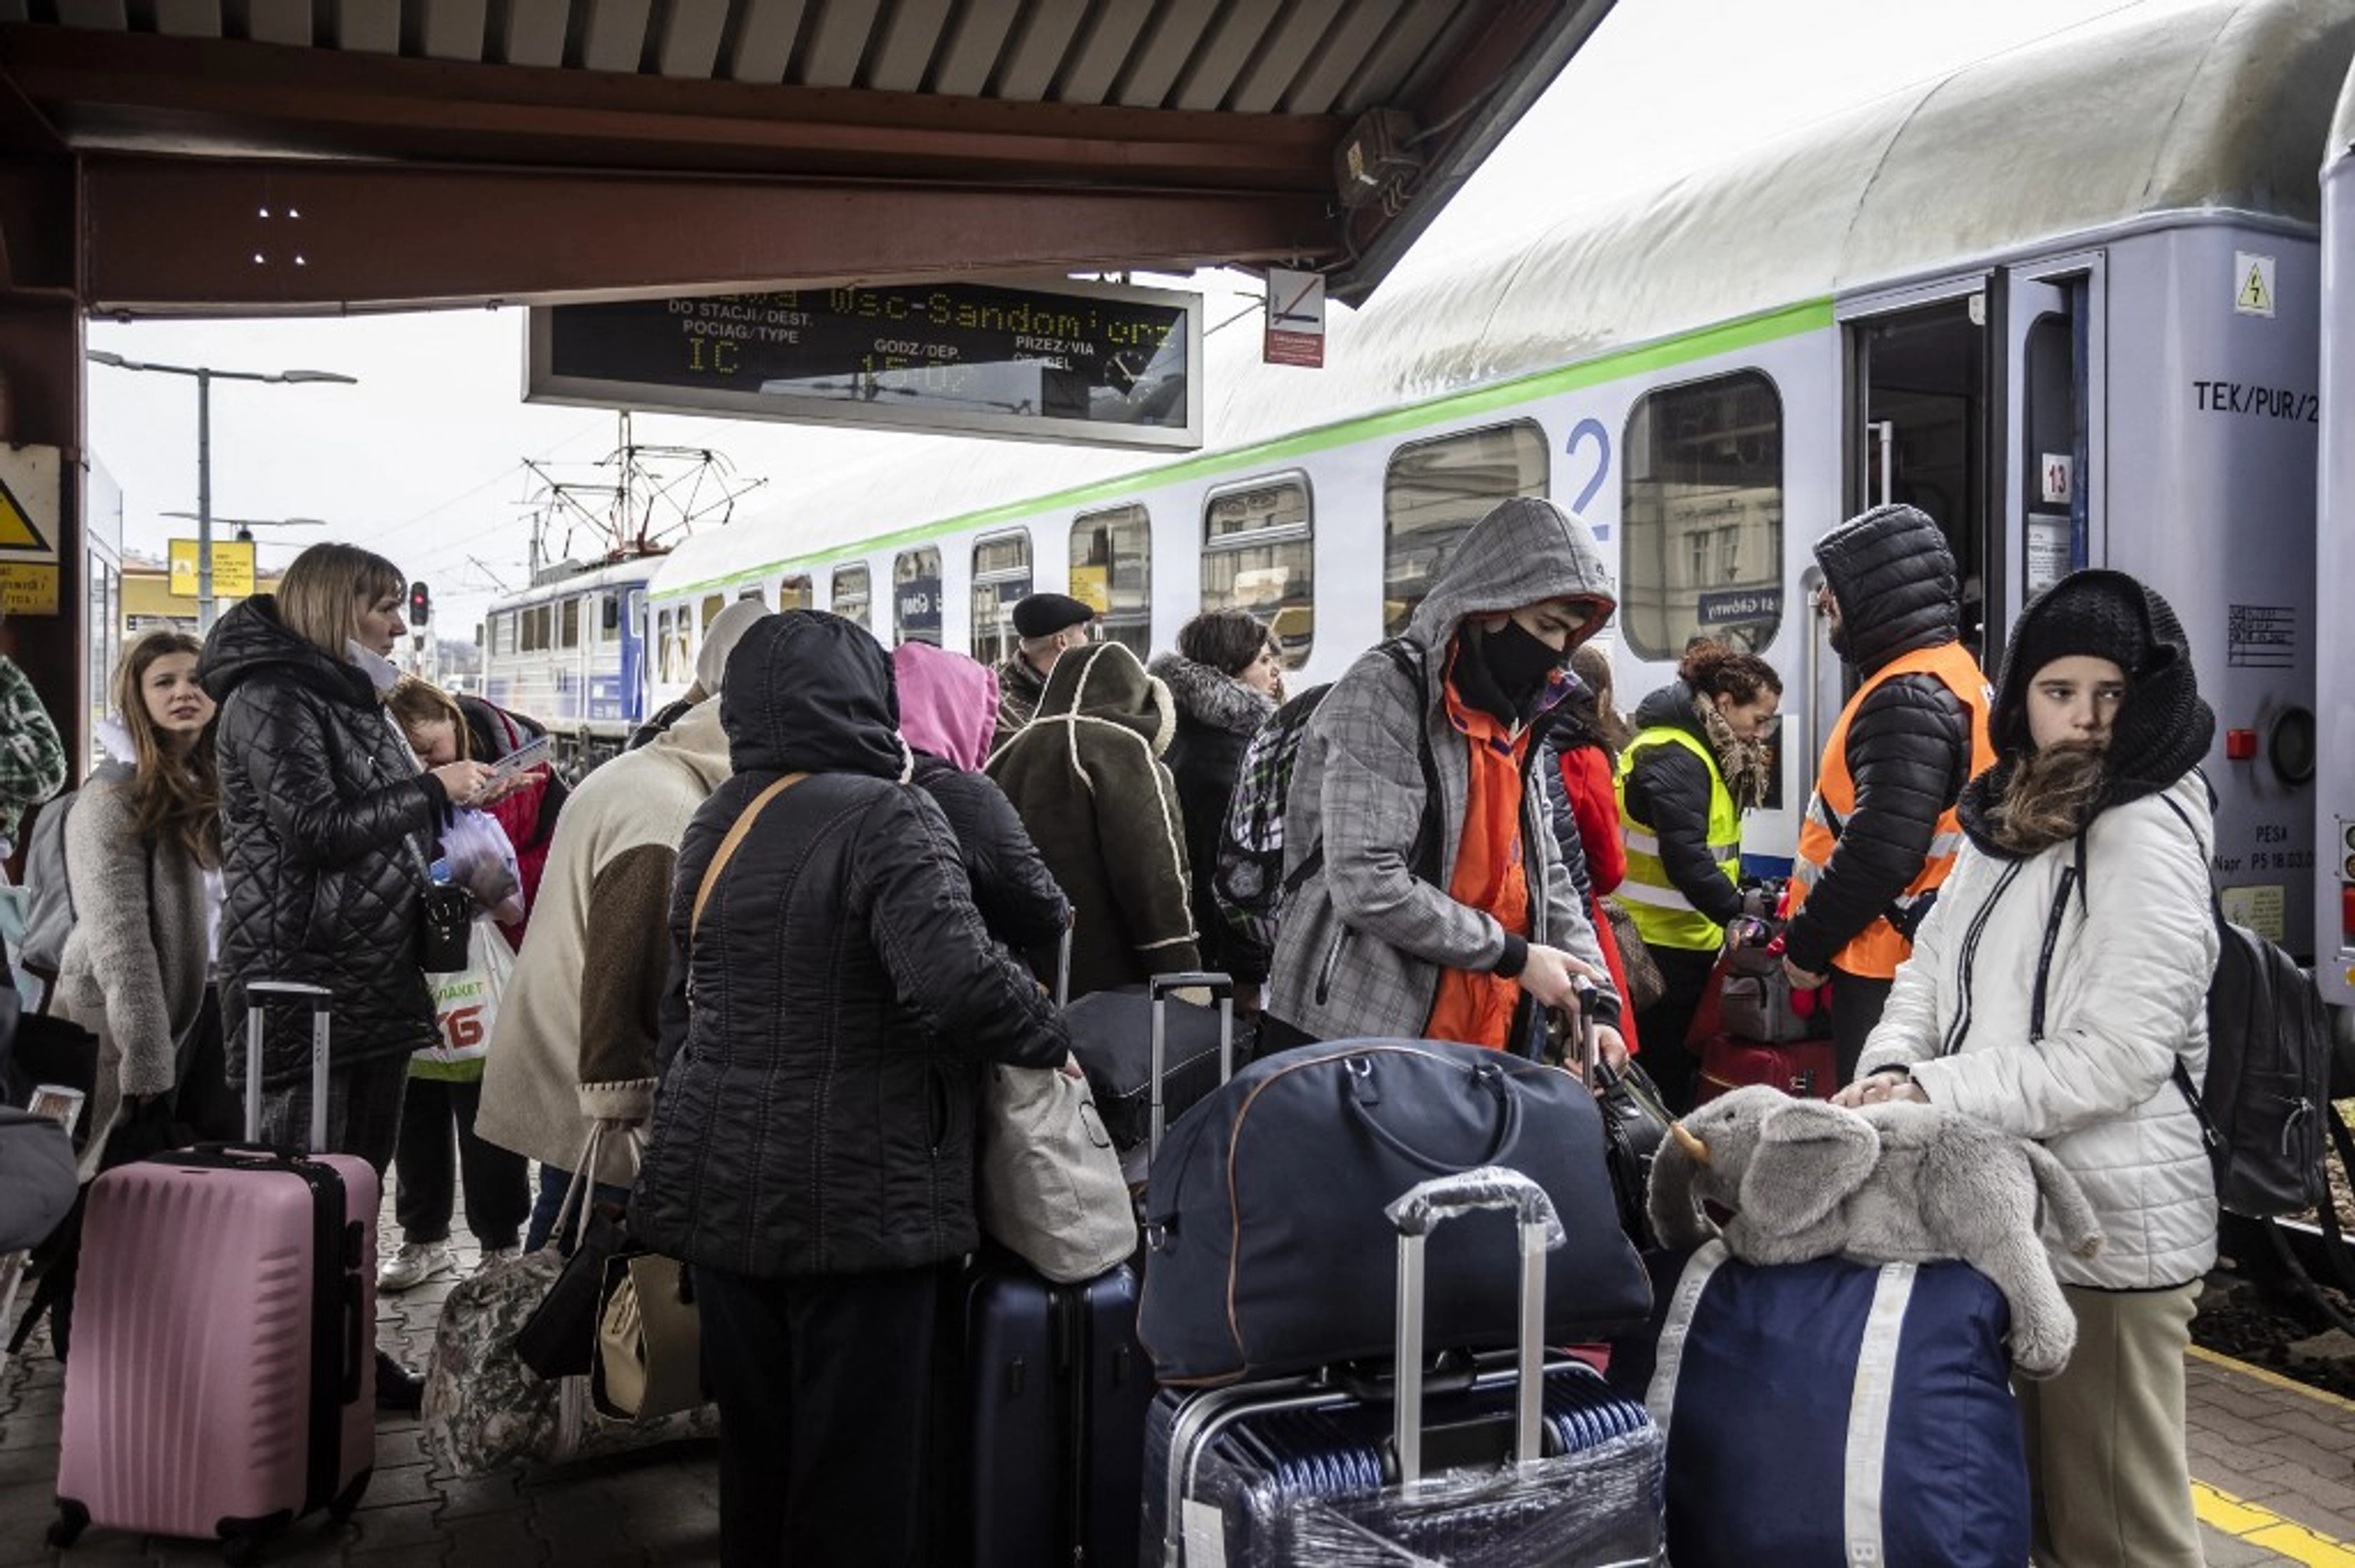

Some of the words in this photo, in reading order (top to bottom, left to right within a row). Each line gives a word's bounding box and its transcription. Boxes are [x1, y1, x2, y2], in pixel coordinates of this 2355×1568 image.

[669, 299, 693, 314] DO
[690, 338, 738, 373] IC
[1016, 335, 1095, 356] PRZEZ/VIA
[2193, 382, 2319, 423] TEK/PUR/2
[1566, 418, 1610, 542] 2
[2049, 464, 2067, 494] 13
[2256, 825, 2288, 843] PESA
